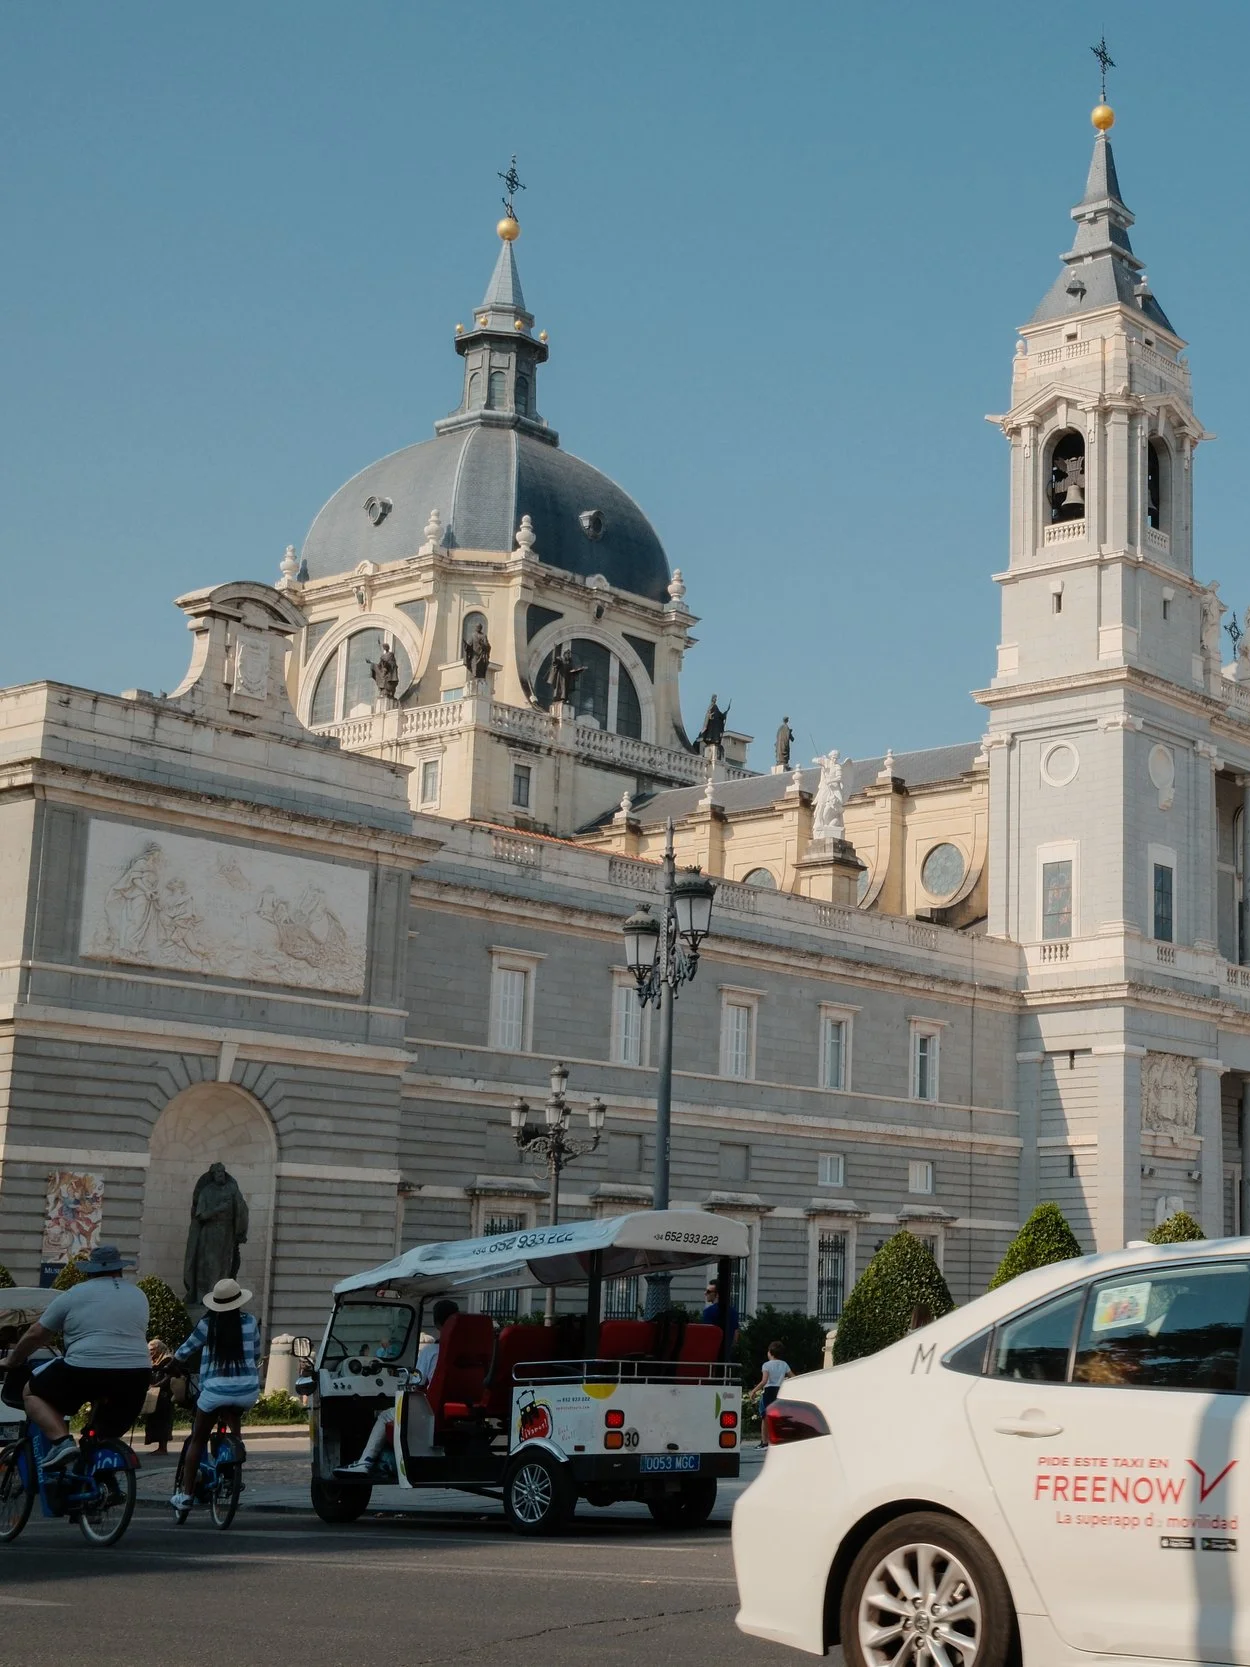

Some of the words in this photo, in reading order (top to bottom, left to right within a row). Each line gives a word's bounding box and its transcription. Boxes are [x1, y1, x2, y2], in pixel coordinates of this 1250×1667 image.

[664, 1230, 682, 1242] 652
[682, 1232, 701, 1244] 933
[700, 1234, 719, 1246] 222
[910, 1342, 938, 1375] M
[624, 1431, 640, 1448] 30
[646, 1456, 672, 1470] 0053
[675, 1455, 695, 1469] MGC
[1037, 1456, 1070, 1467] PIDE
[1073, 1457, 1109, 1467] ESTE
[1112, 1458, 1144, 1468] TAXI
[1148, 1458, 1170, 1468] EN
[1034, 1475, 1187, 1504] FREENOW
[1056, 1511, 1072, 1525] La
[1075, 1513, 1141, 1529] superapp
